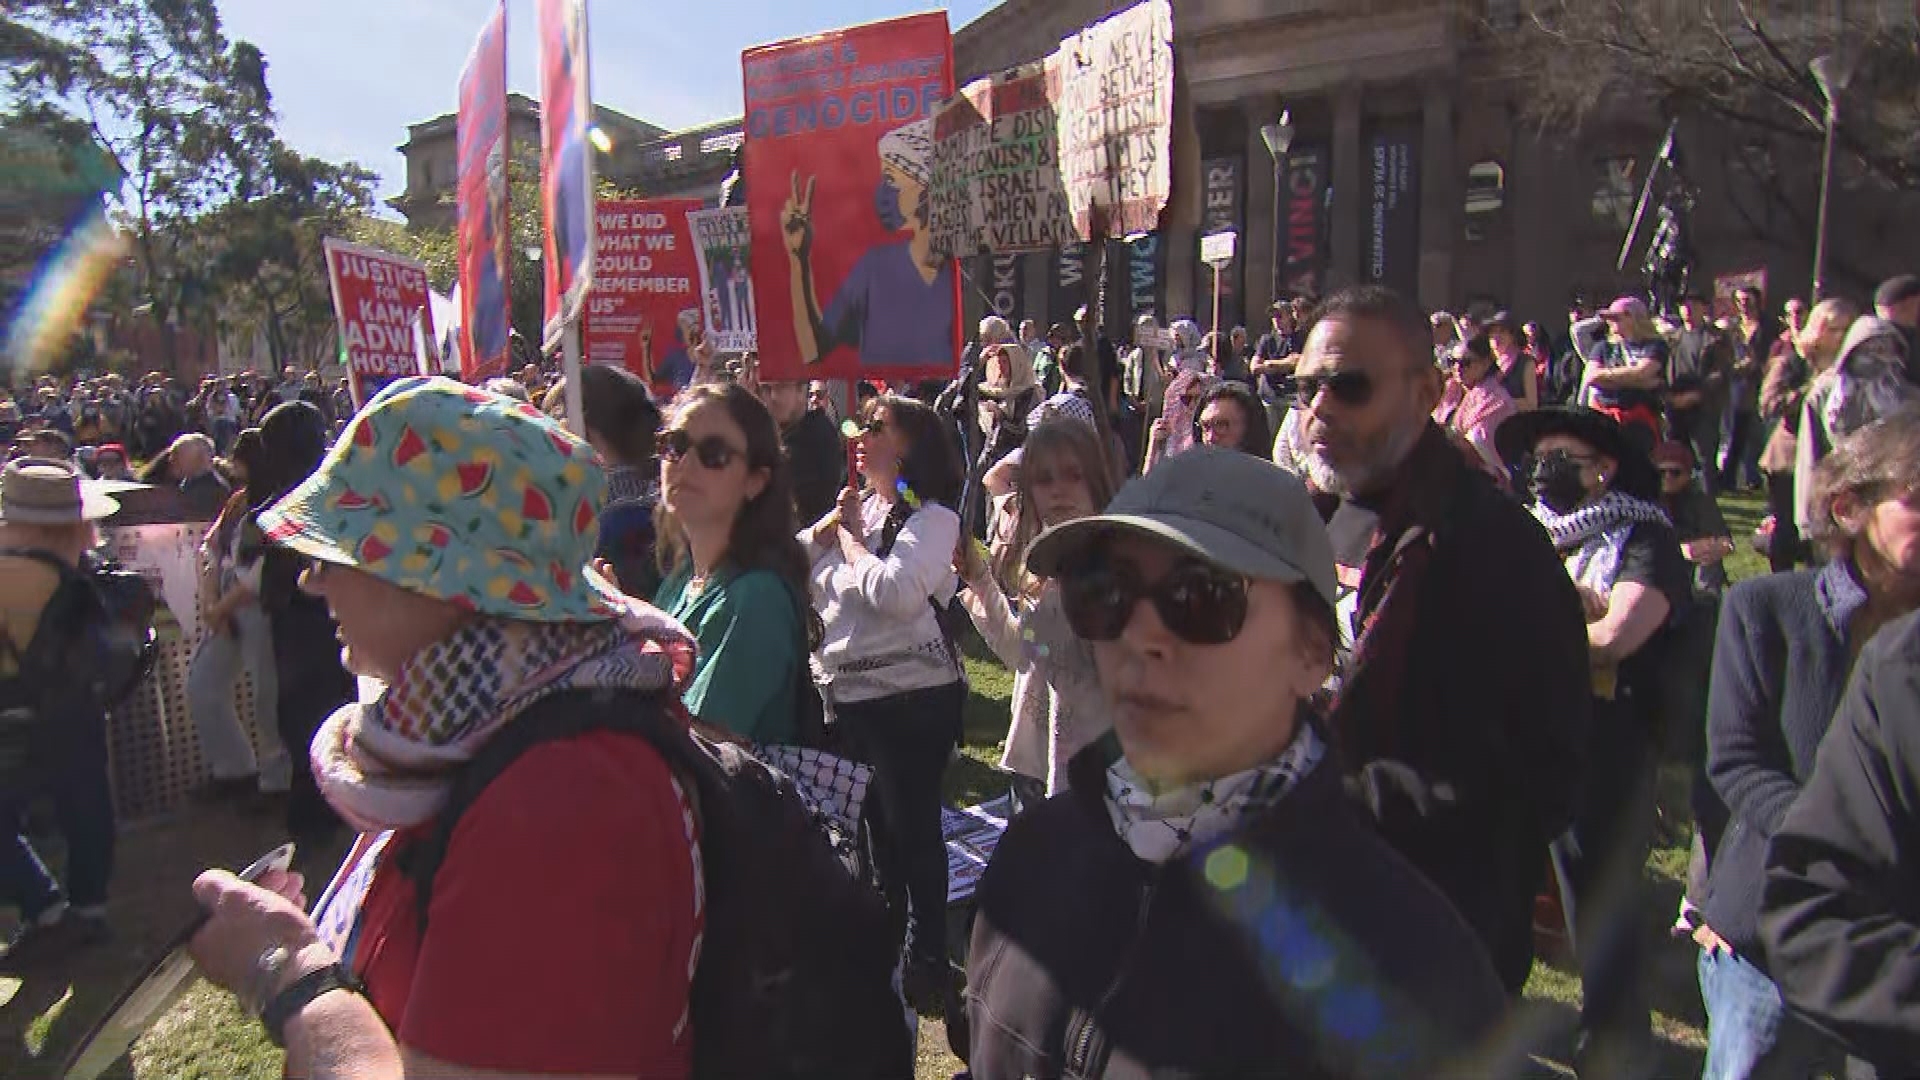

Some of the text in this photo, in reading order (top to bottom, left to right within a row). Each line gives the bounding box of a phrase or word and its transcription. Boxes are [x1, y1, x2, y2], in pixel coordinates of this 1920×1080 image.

[977, 169, 1046, 201] ISRAEL
[631, 212, 667, 231] DID
[980, 194, 1036, 225] WHEN
[1287, 155, 1317, 263] VINCI
[644, 233, 676, 252] WE
[339, 253, 426, 294] JUSTICE
[592, 276, 691, 294] REMEMBER
